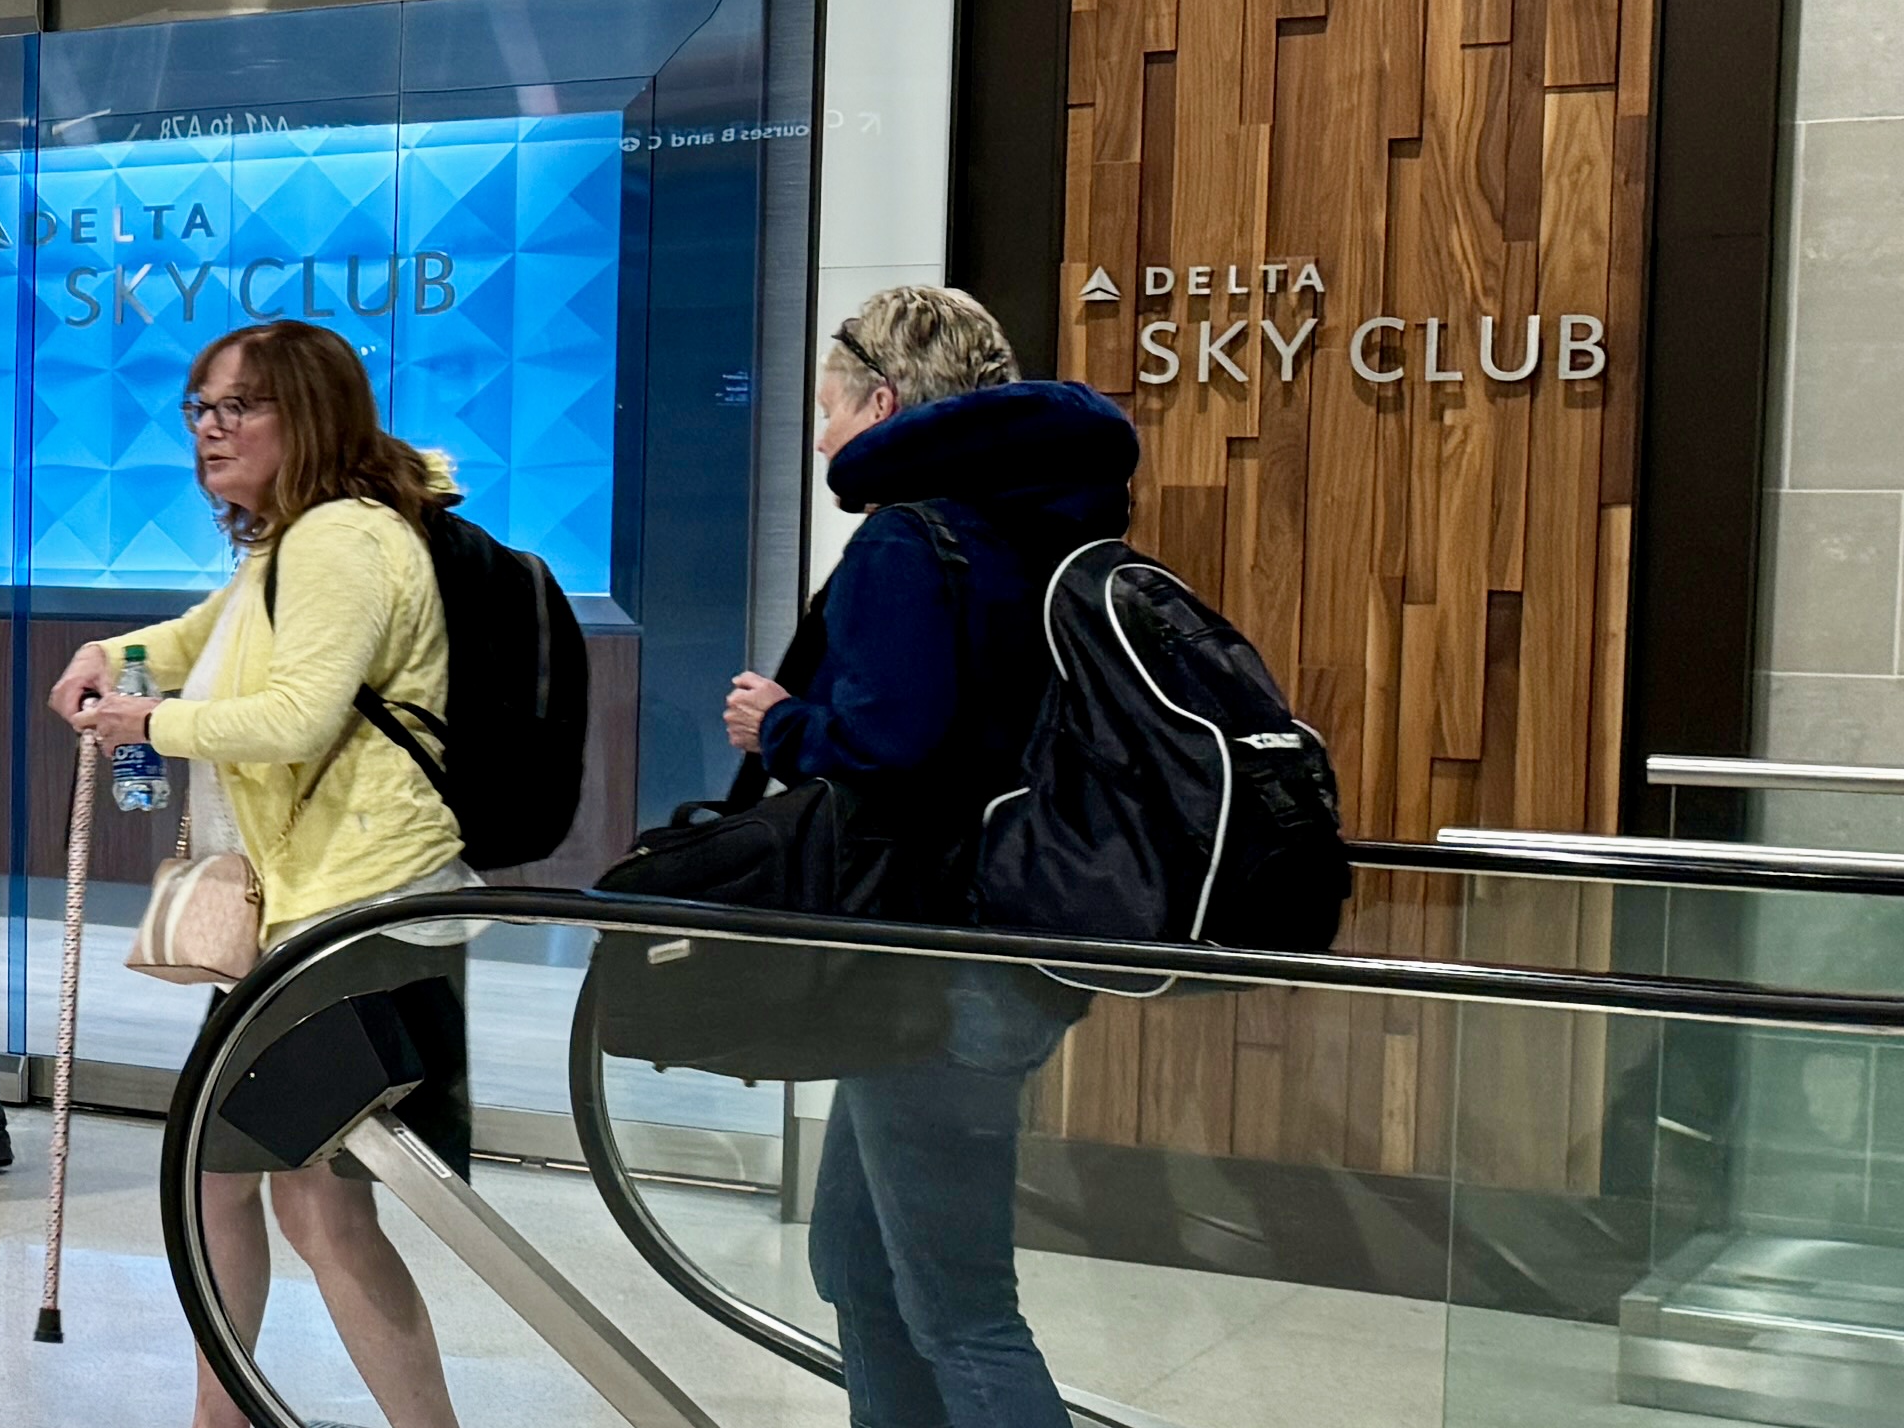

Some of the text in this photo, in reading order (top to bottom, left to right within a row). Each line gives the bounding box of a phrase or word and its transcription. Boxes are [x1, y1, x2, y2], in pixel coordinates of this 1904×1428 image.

[25, 202, 215, 246] DELTA
[65, 251, 456, 328] SKY CLUB
[1145, 263, 1325, 296] DELTA
[1138, 314, 1607, 385] SKY CLUB
